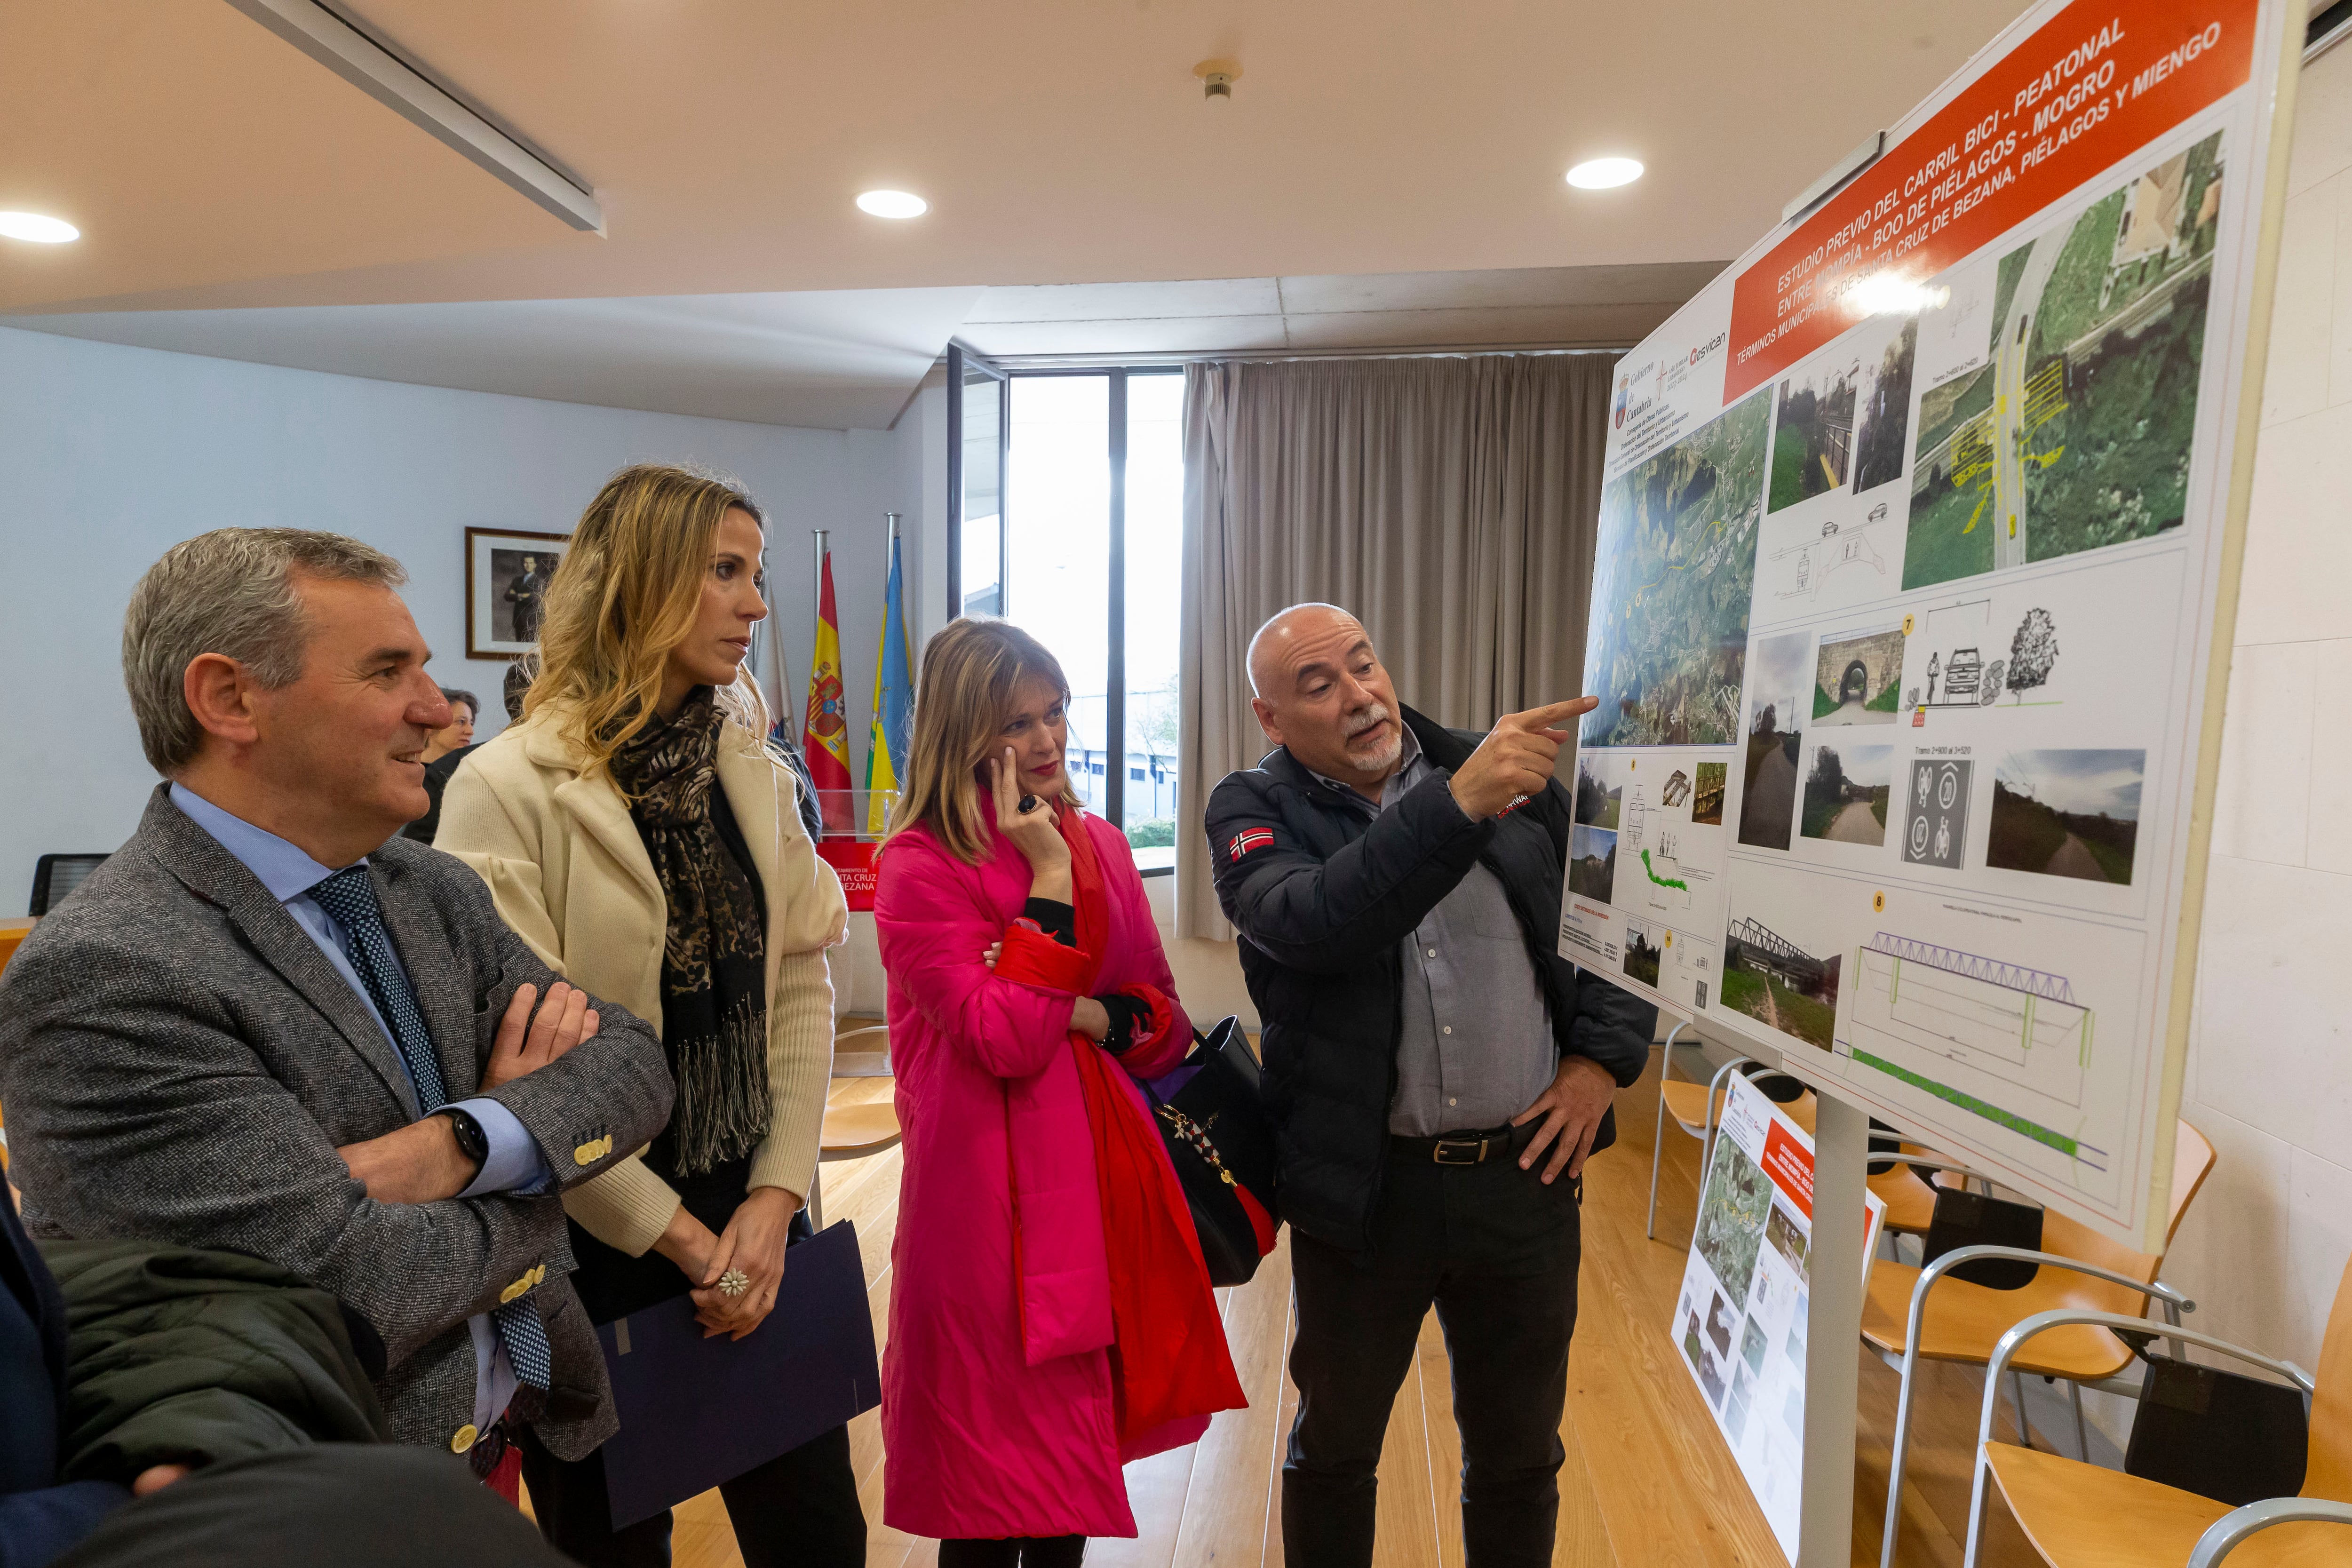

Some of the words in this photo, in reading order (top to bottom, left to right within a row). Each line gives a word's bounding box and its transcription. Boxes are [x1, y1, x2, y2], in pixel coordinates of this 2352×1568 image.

[1778, 246, 1823, 294] ESTUDIO
[1826, 209, 1871, 253] PREVIO
[1874, 188, 1900, 222] DEL
[1904, 143, 1960, 197] CARRIL
[1964, 110, 1999, 154] BICI
[2014, 17, 2125, 117] PEATONAL
[1737, 328, 1776, 366] TÉRMINOS
[1778, 286, 1837, 339] MUNICIPALES
[1840, 278, 1854, 296] DE
[1857, 248, 1892, 285] SANTA
[1896, 222, 1929, 257] CRUZ
[1932, 207, 1950, 234] DE
[1953, 166, 2016, 220] BEZANA,
[2020, 97, 2110, 174] PIÉLAGOS
[2115, 83, 2129, 110] Y
[2131, 21, 2221, 99] MIENGO
[1778, 279, 1812, 318] ENTRE
[1815, 243, 1862, 290] MOMPÍA
[1873, 213, 1903, 250] BOO
[1907, 194, 1927, 226] DE
[1931, 130, 2017, 209] PIÉLAGOS
[2033, 59, 2114, 136] MOGRO
[1690, 332, 1725, 366] Gesvican
[1630, 361, 1654, 386] Gobierno
[1627, 396, 1652, 422] Cantabria
[1629, 392, 1635, 404] de
[1907, 619, 1911, 629] 7
[1877, 896, 1881, 907] 8
